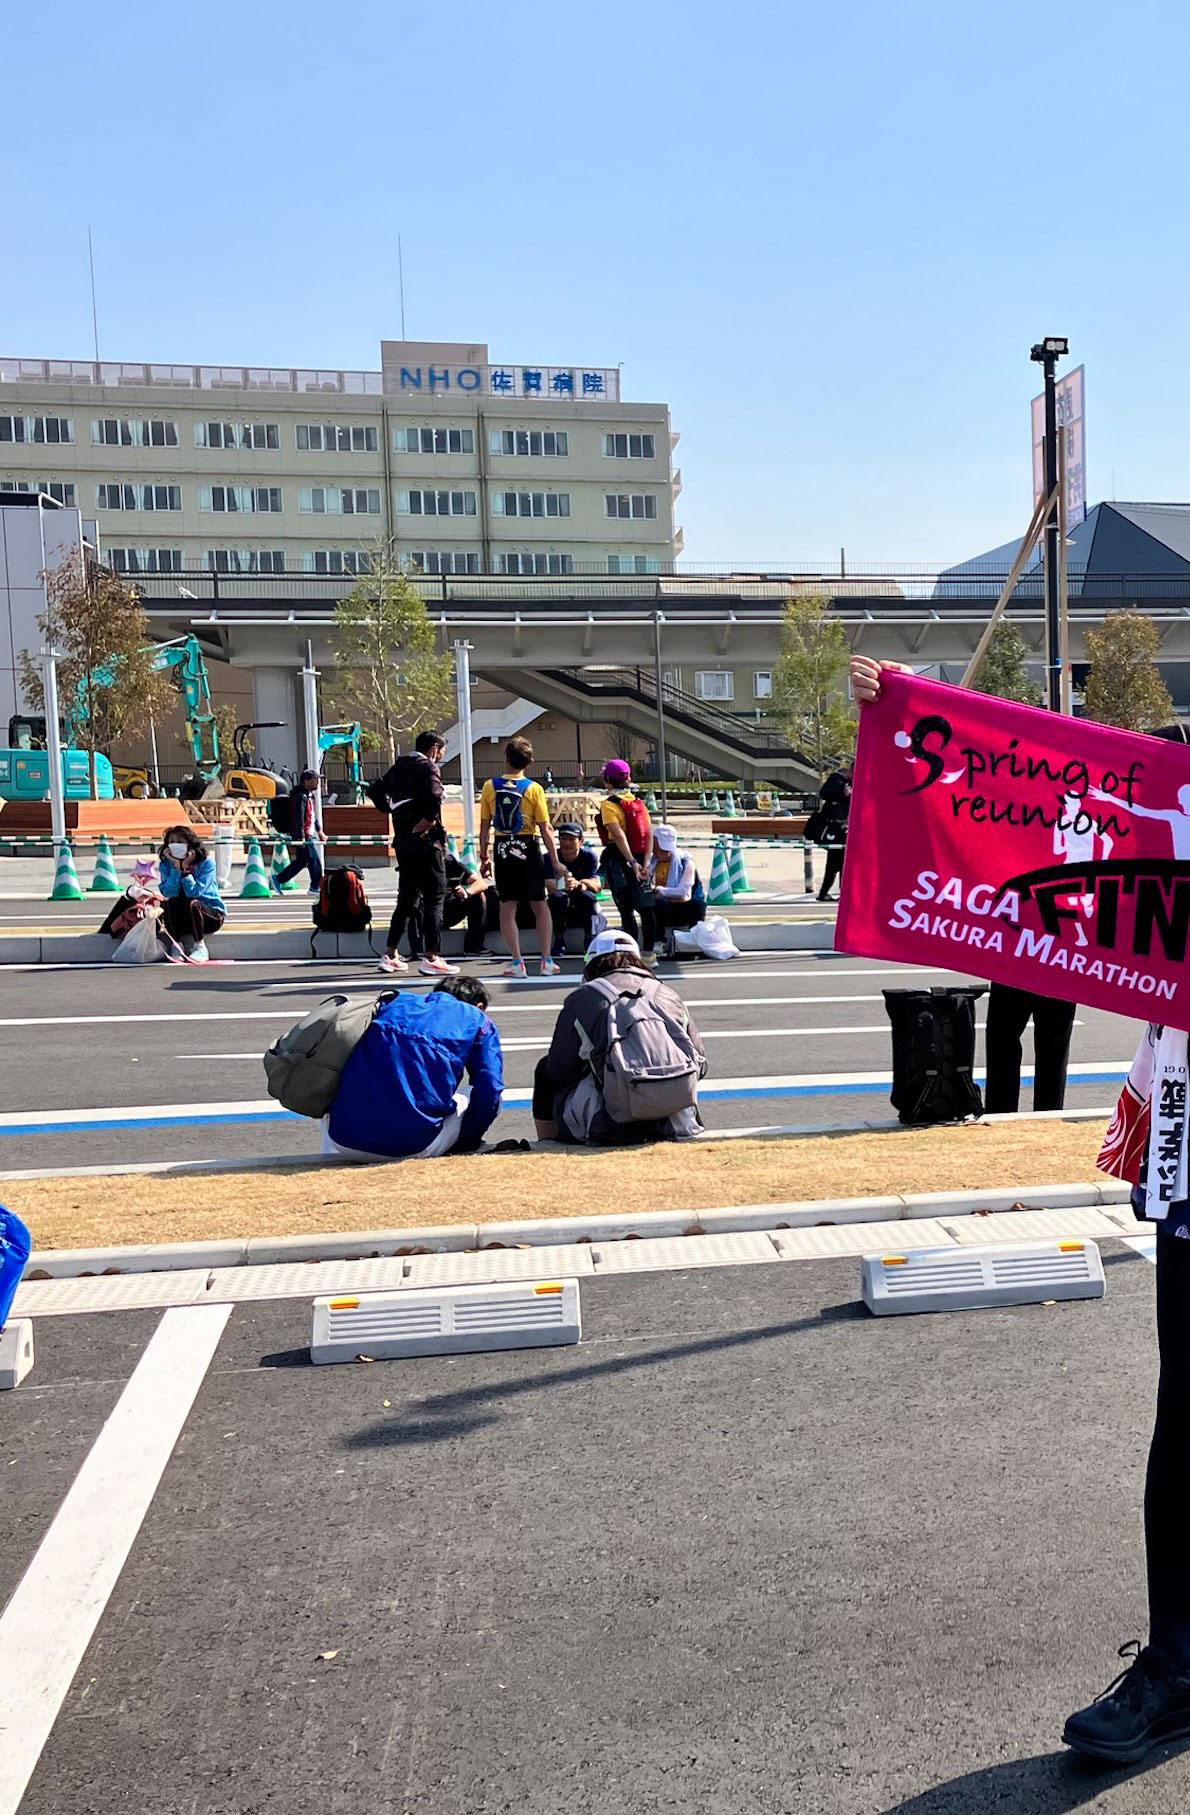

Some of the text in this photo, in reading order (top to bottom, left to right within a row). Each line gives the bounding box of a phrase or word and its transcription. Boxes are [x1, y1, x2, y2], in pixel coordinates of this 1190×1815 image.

[400, 367, 605, 393] NHO 佐賀病院
[898, 715, 1144, 808] Spring of
[952, 792, 1130, 838] reunion
[912, 870, 1021, 923] SAGA
[888, 898, 1178, 1000] SAKURA MARATHON
